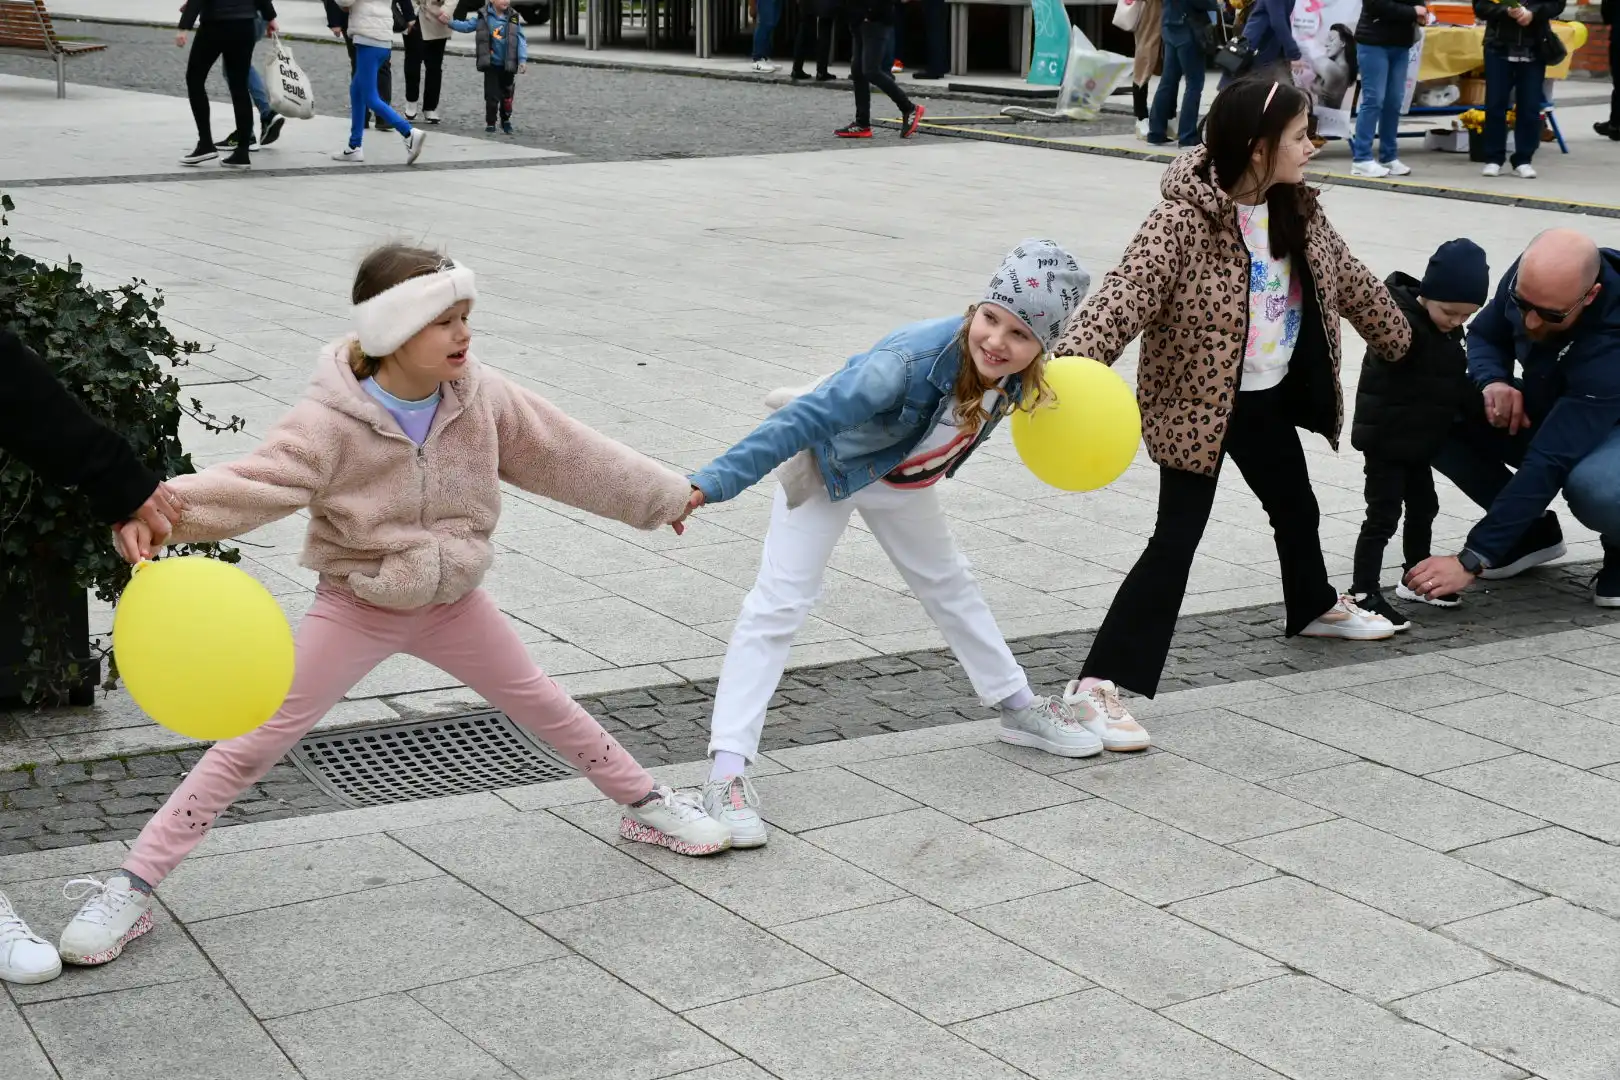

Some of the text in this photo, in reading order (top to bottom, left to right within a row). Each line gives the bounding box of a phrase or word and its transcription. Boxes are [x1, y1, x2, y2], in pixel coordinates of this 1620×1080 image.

[1037, 258, 1059, 269] cool
[1008, 268, 1023, 294] music
[991, 292, 1014, 304] free
